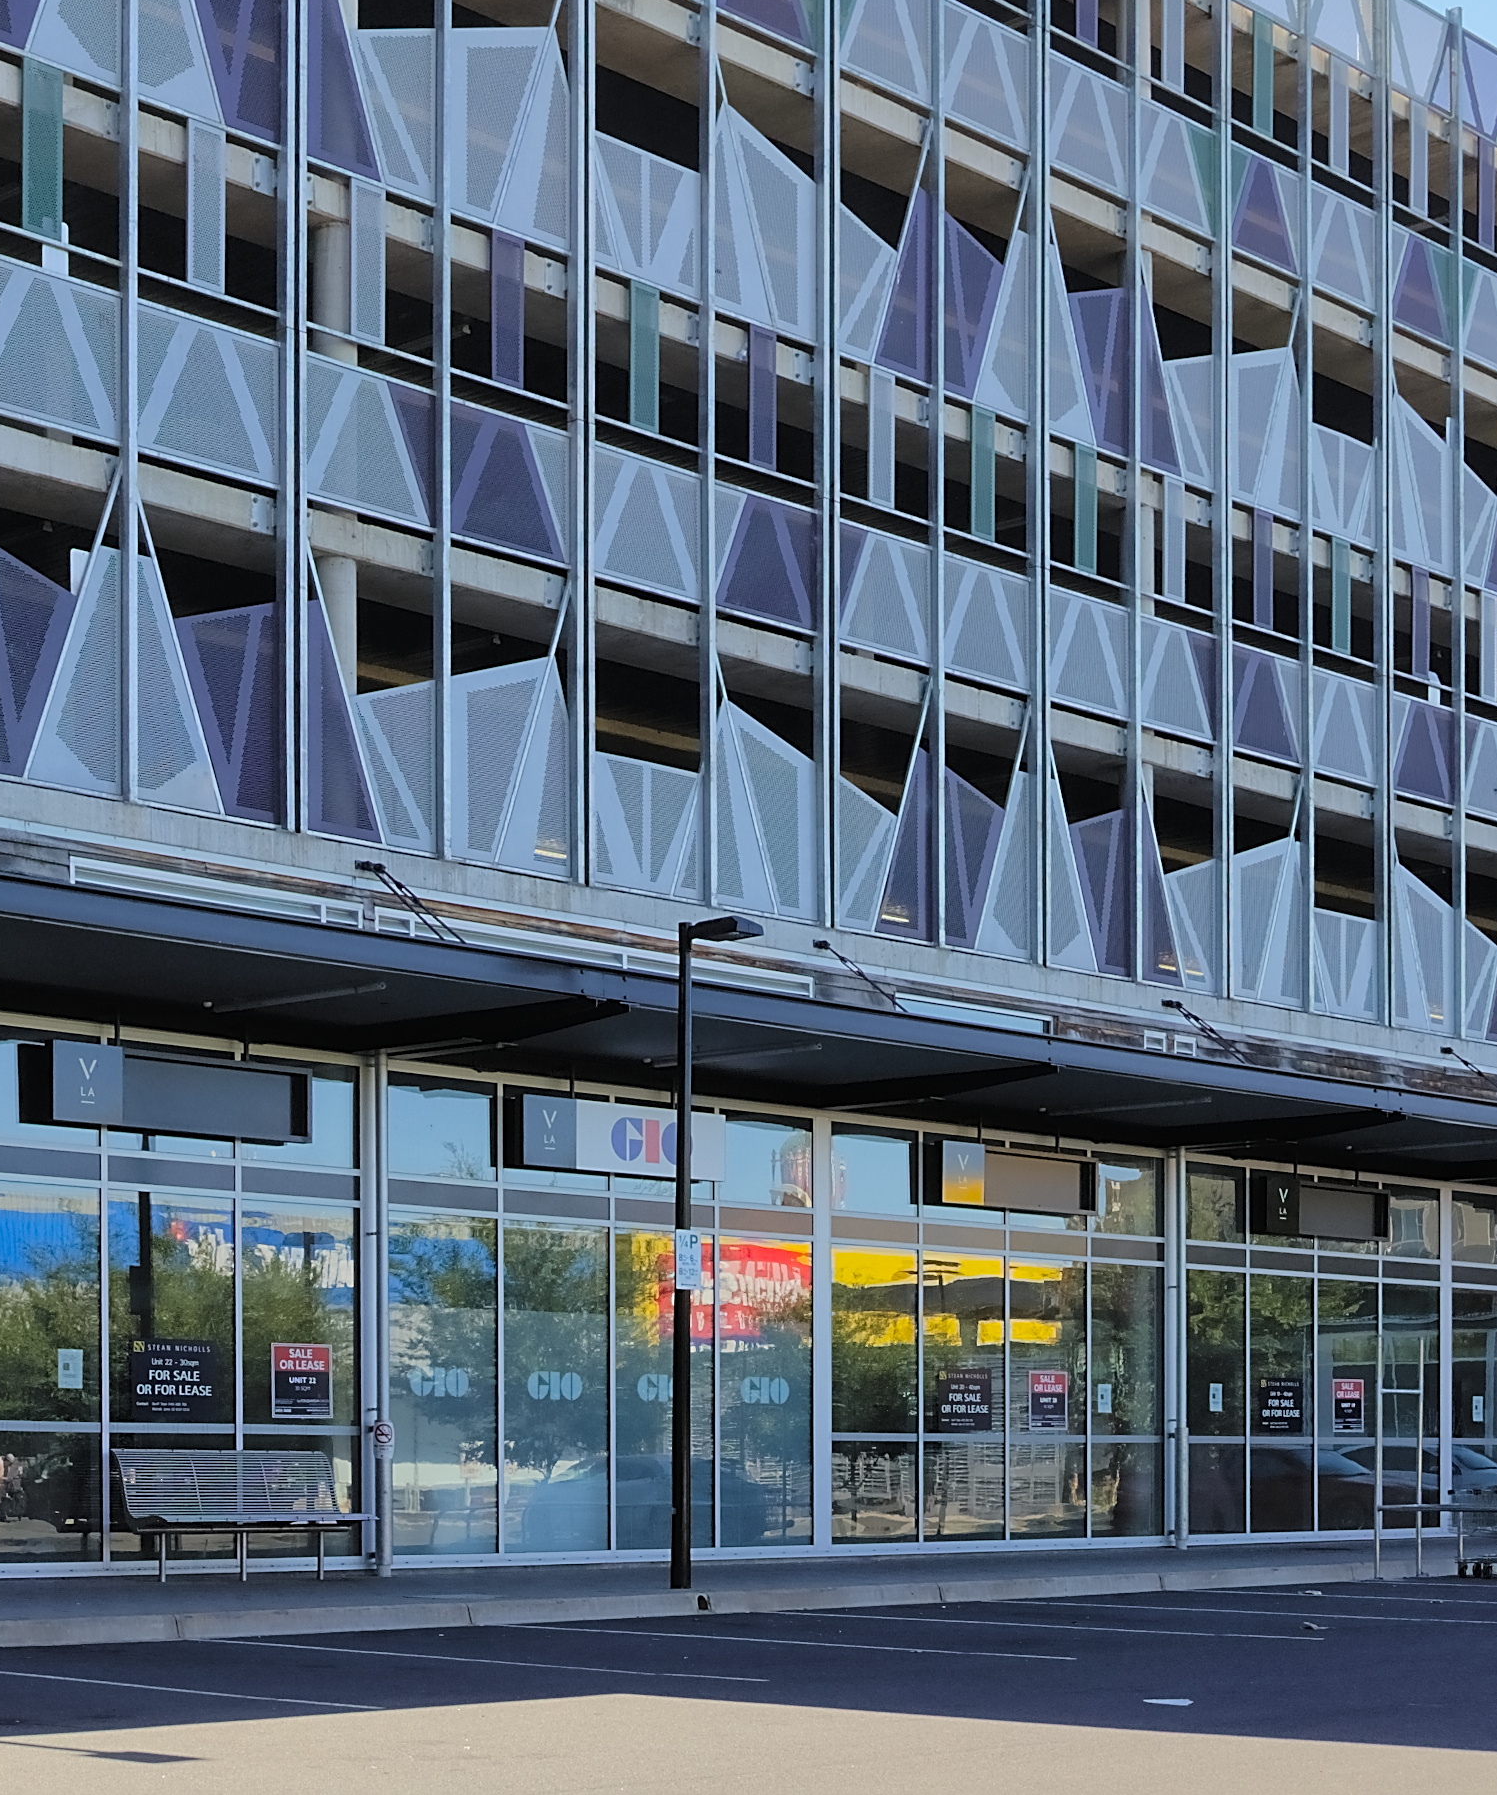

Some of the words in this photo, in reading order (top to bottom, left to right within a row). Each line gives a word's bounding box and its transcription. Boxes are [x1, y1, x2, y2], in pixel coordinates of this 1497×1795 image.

[78, 1057, 97, 1080] V
[80, 1086, 95, 1097] LA
[542, 1109, 557, 1129] V
[543, 1134, 555, 1144] LA
[611, 1116, 693, 1166] GIO
[958, 1154, 969, 1170] V
[1279, 1187, 1288, 1202] V
[690, 1235, 698, 1248] P
[174, 1345, 211, 1353] NICHOLLS
[289, 1348, 313, 1358] SALE
[151, 1358, 163, 1366] Unit
[279, 1359, 294, 1370] OR
[296, 1360, 325, 1370] LEASE
[148, 1369, 171, 1381] FOR
[173, 1370, 200, 1381] SALE
[289, 1376, 307, 1384] UNIT
[1039, 1375, 1055, 1383] SALE
[409, 1366, 469, 1398] GIO
[527, 1371, 583, 1401] GIO
[136, 1384, 152, 1395] OR
[154, 1384, 176, 1395] FOR
[178, 1385, 212, 1396] LEASE
[637, 1373, 673, 1403] GI
[740, 1376, 790, 1405] GIO
[1033, 1384, 1044, 1392] OR
[1044, 1384, 1063, 1392] LEASE
[949, 1393, 963, 1402] FOR
[964, 1393, 981, 1402] SALE
[1268, 1399, 1279, 1407] FOR
[1280, 1399, 1294, 1407] SALE
[941, 1405, 952, 1413] OR
[953, 1405, 966, 1413] FOR
[968, 1405, 989, 1414] LEASE
[1262, 1409, 1270, 1417] OR
